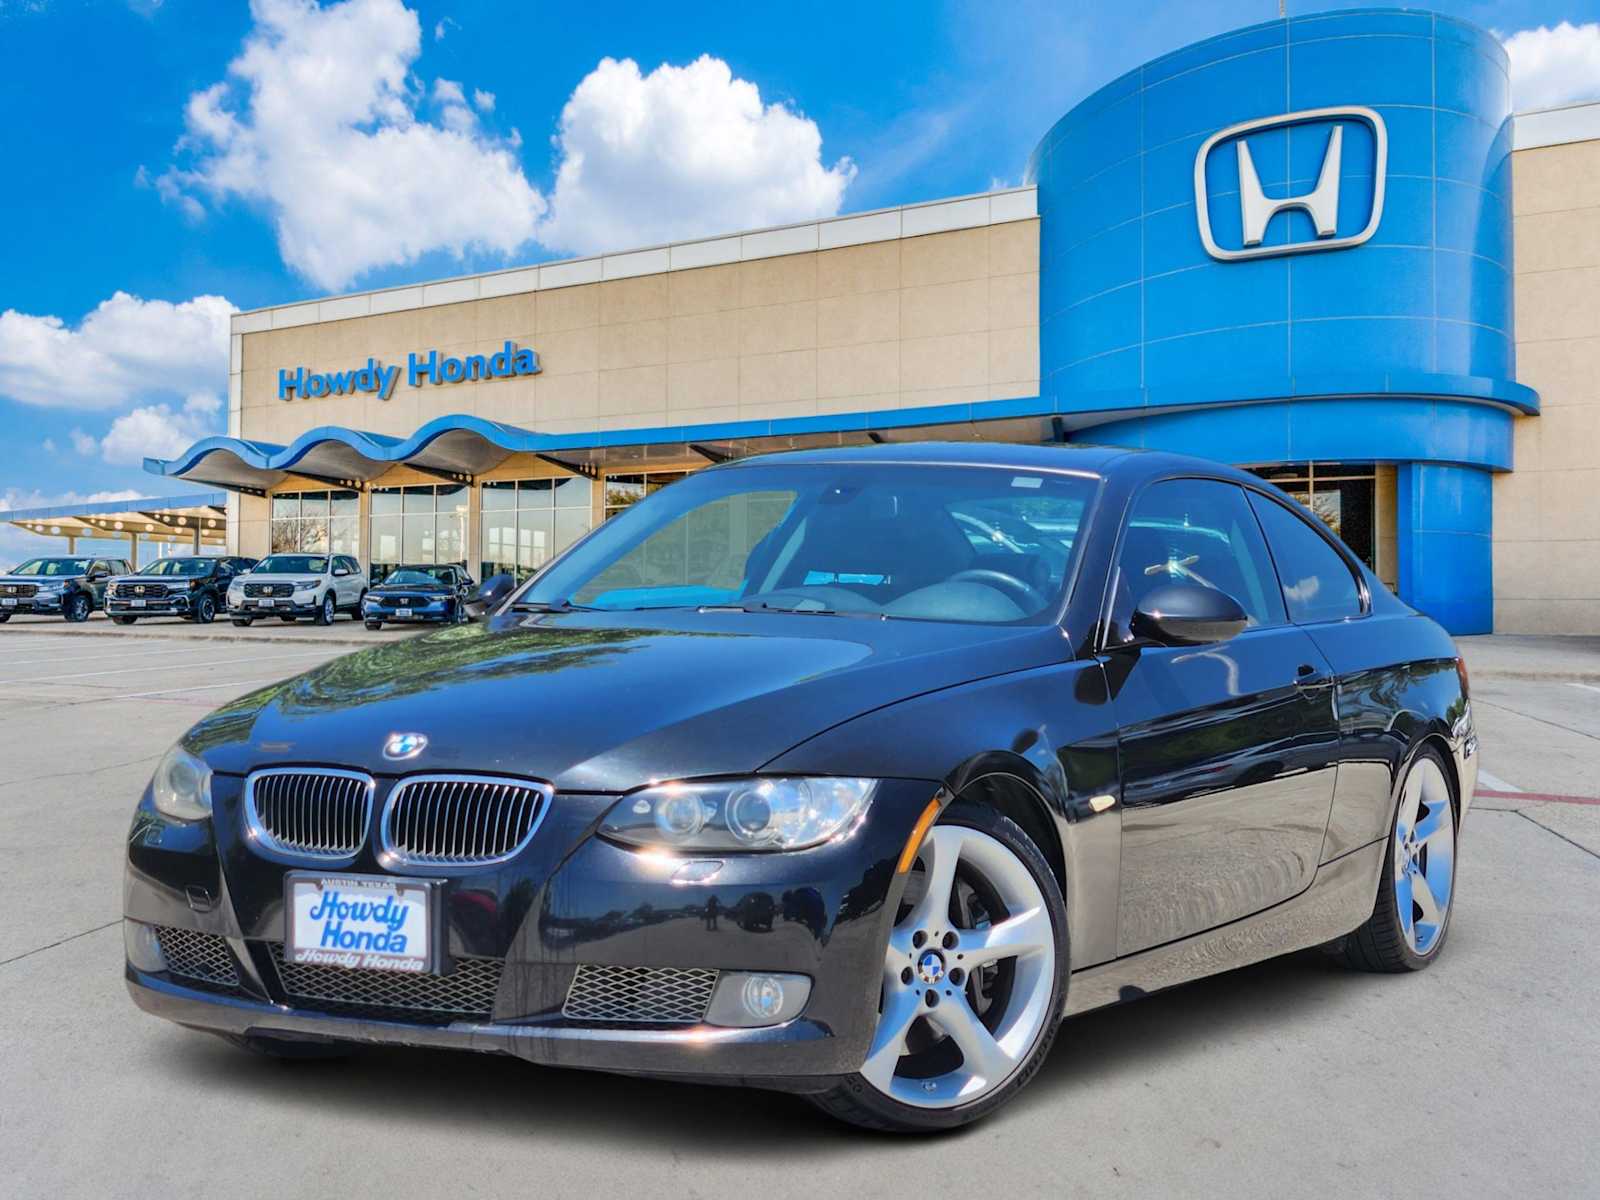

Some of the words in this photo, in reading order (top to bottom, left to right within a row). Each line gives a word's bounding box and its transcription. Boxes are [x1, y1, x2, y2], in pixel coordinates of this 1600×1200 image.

[279, 358, 402, 401] Howdy
[408, 341, 542, 387] Honda
[310, 891, 409, 931] Howdy
[320, 921, 408, 953] Honda
[295, 950, 361, 968] Howdy
[363, 953, 424, 971] Honda
